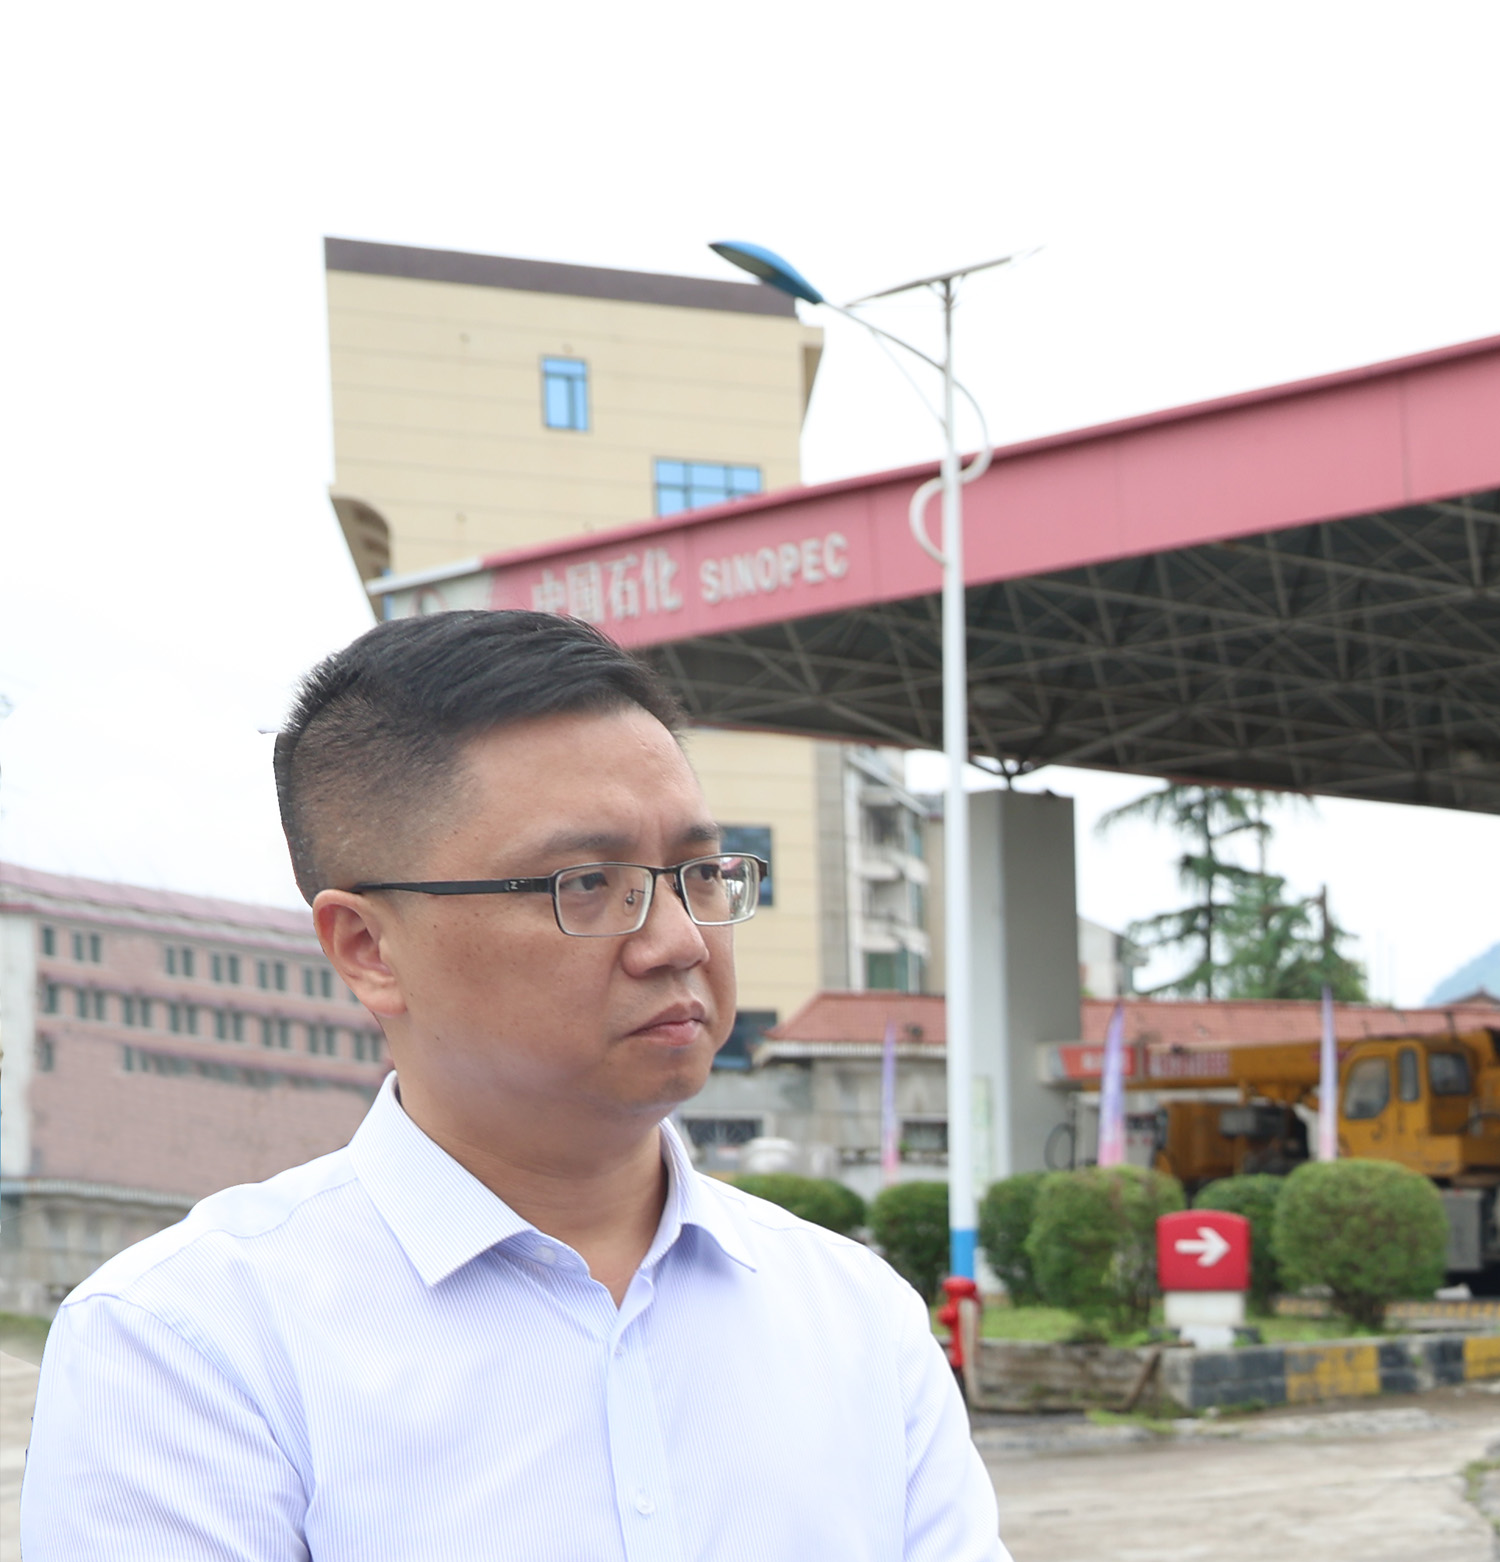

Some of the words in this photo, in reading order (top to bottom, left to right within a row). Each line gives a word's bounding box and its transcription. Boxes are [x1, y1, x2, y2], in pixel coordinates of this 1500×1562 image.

[531, 546, 683, 624] 中国石化
[700, 532, 849, 605] SINOPEC
